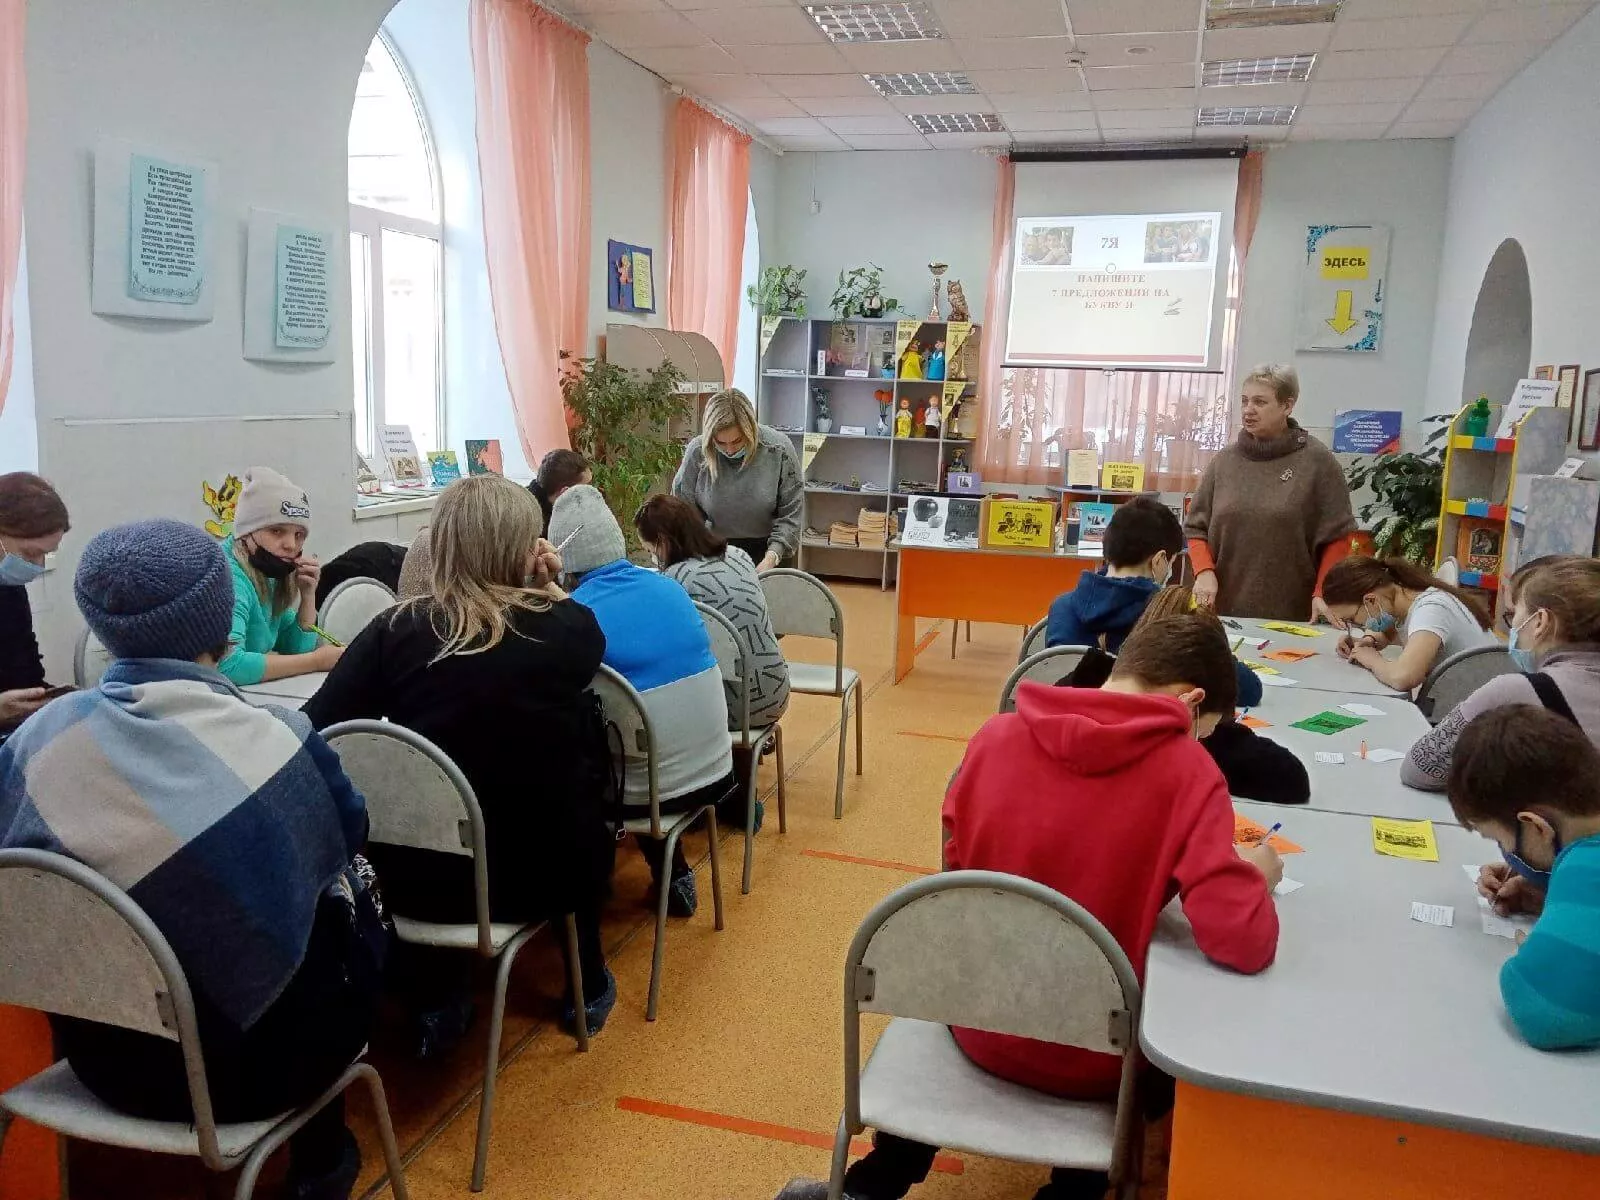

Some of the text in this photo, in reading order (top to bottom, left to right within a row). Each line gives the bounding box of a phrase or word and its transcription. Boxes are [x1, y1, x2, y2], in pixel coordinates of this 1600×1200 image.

[1101, 237, 1119, 249] 7Я
[1324, 257, 1366, 268] ЗДЕСЬ
[1078, 274, 1146, 283] НАПИШИТЕ
[1154, 289, 1170, 297] НА
[1085, 301, 1121, 309] БУКВУ
